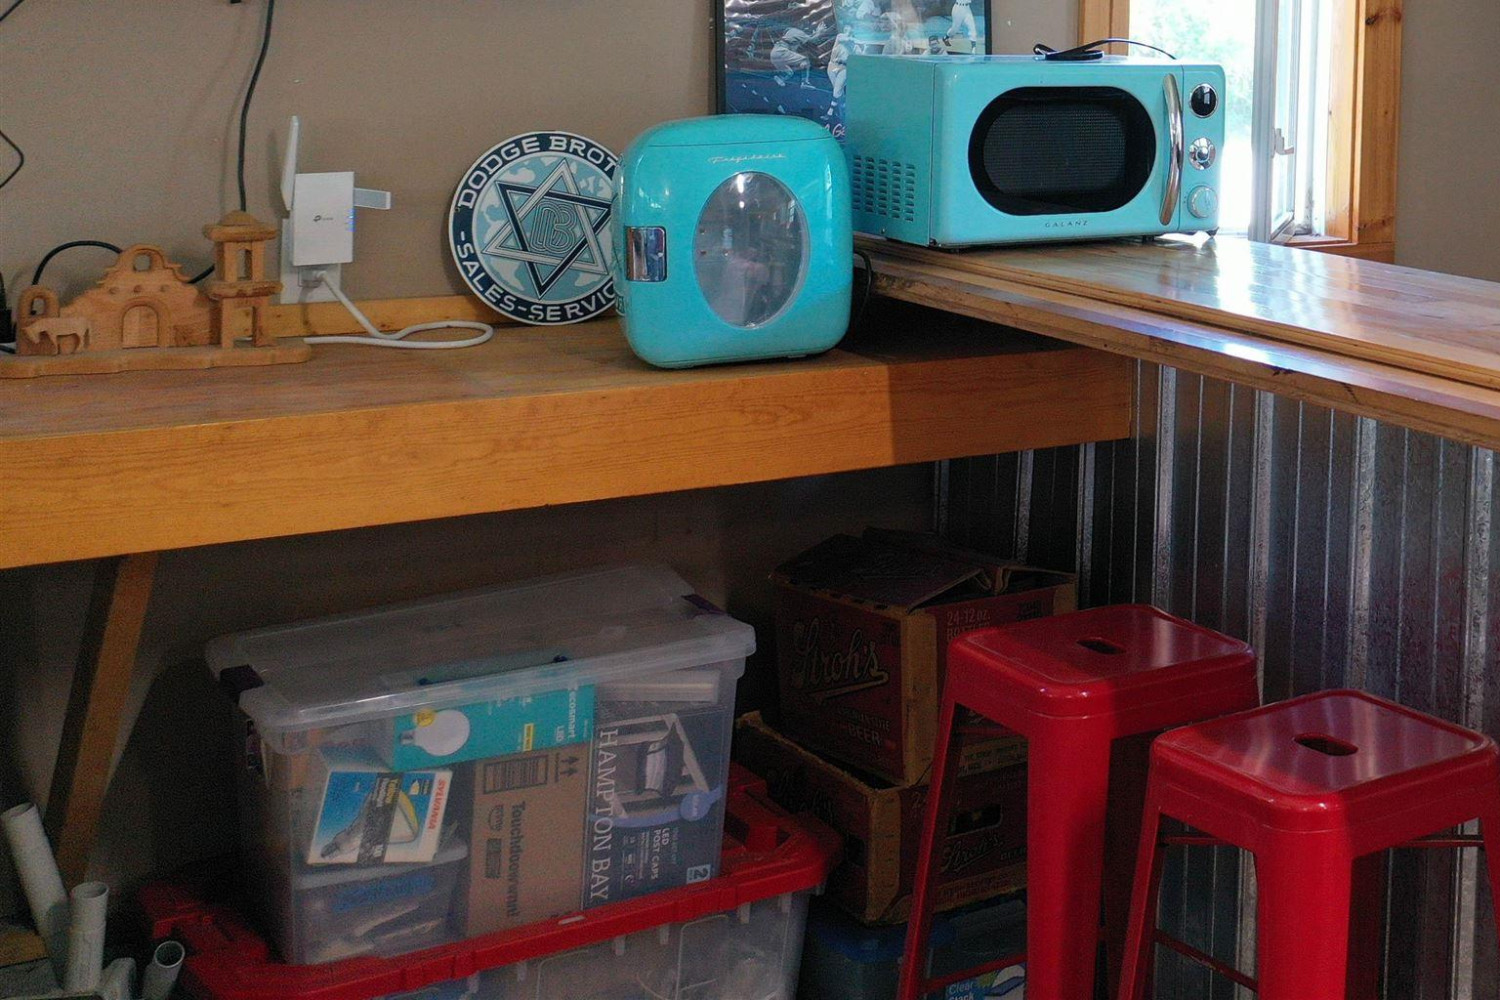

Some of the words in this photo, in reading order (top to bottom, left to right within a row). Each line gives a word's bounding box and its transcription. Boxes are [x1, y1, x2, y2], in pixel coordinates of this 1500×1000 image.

[458, 136, 540, 209] DODGE
[549, 136, 619, 171] BROT
[1045, 220, 1088, 228] GALANZ
[427, 780, 447, 830] SYLVANIA
[594, 728, 618, 851] HAMPTON
[652, 829, 662, 853] POST
[661, 827, 670, 846] LED
[590, 857, 612, 900] BAY
